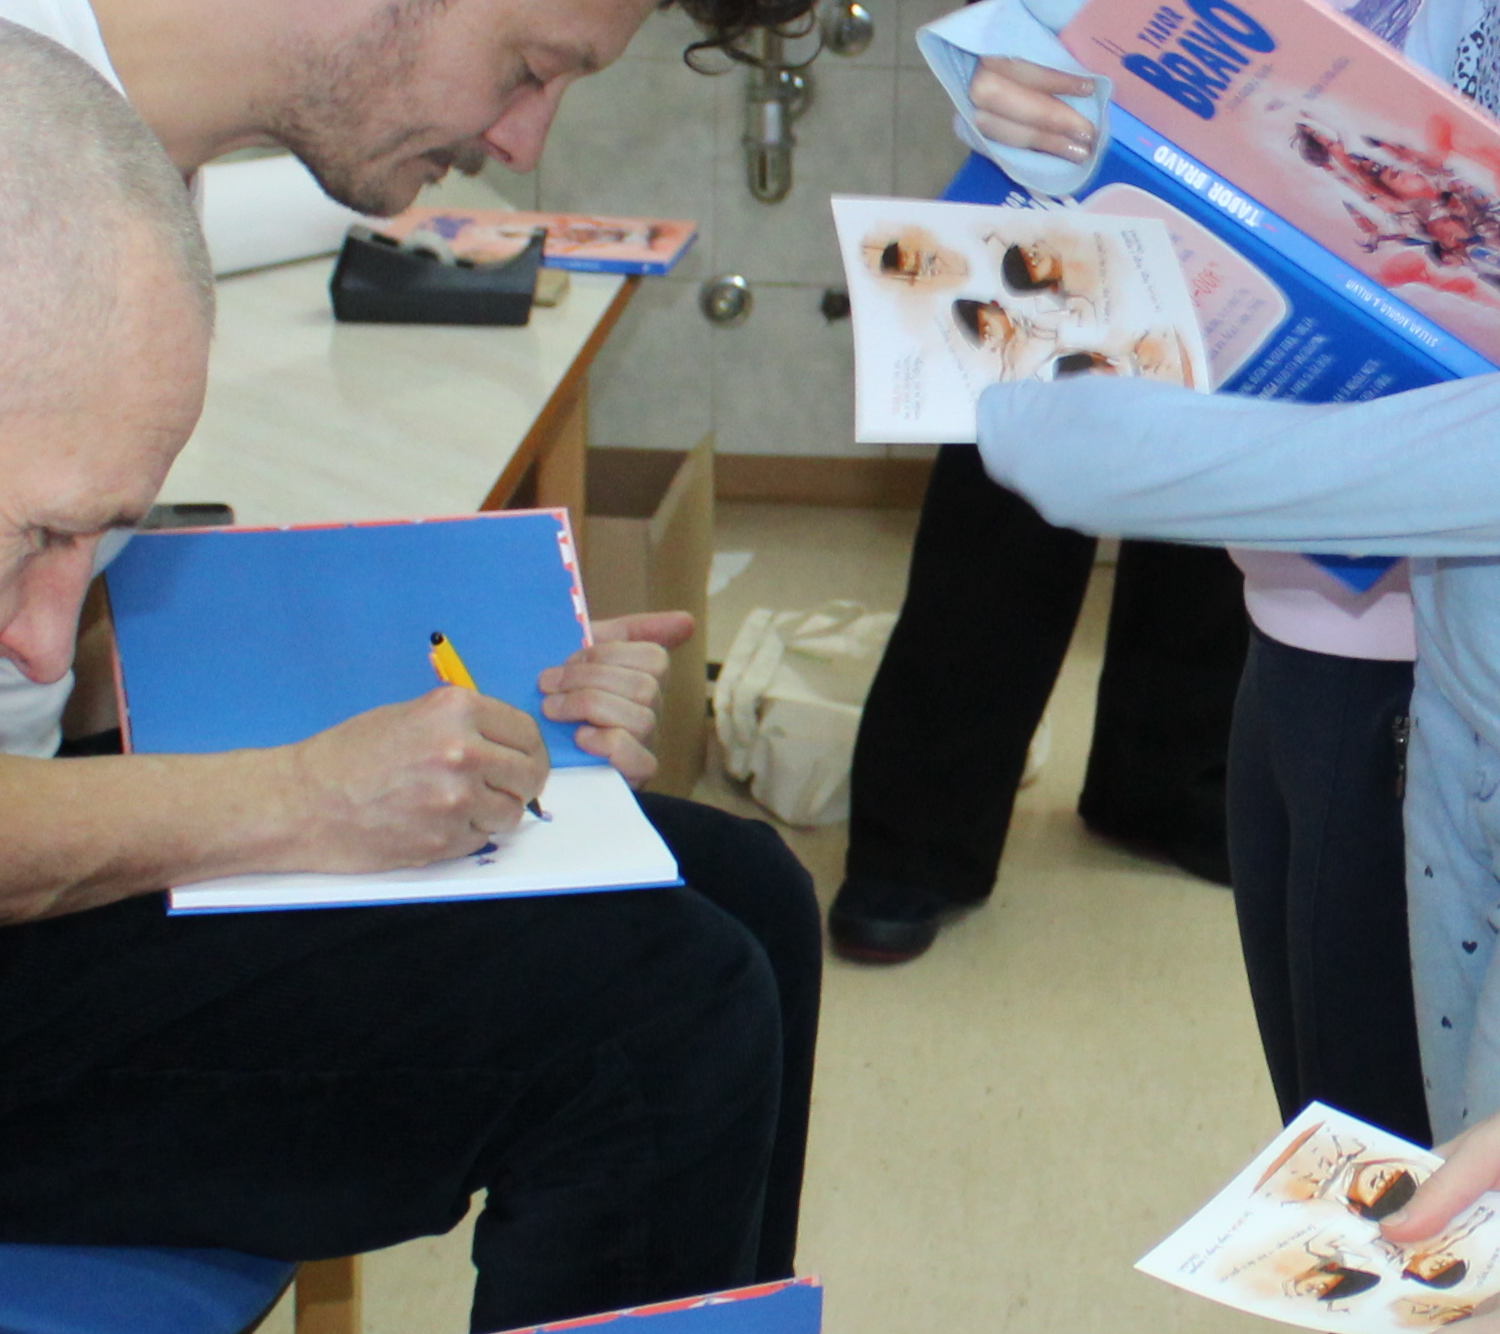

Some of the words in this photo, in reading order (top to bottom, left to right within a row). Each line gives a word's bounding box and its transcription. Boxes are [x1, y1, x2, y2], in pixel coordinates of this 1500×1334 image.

[1137, 5, 1185, 48] TABOR
[1152, 143, 1209, 195] BRAVO
[1209, 180, 1264, 229] TABOR
